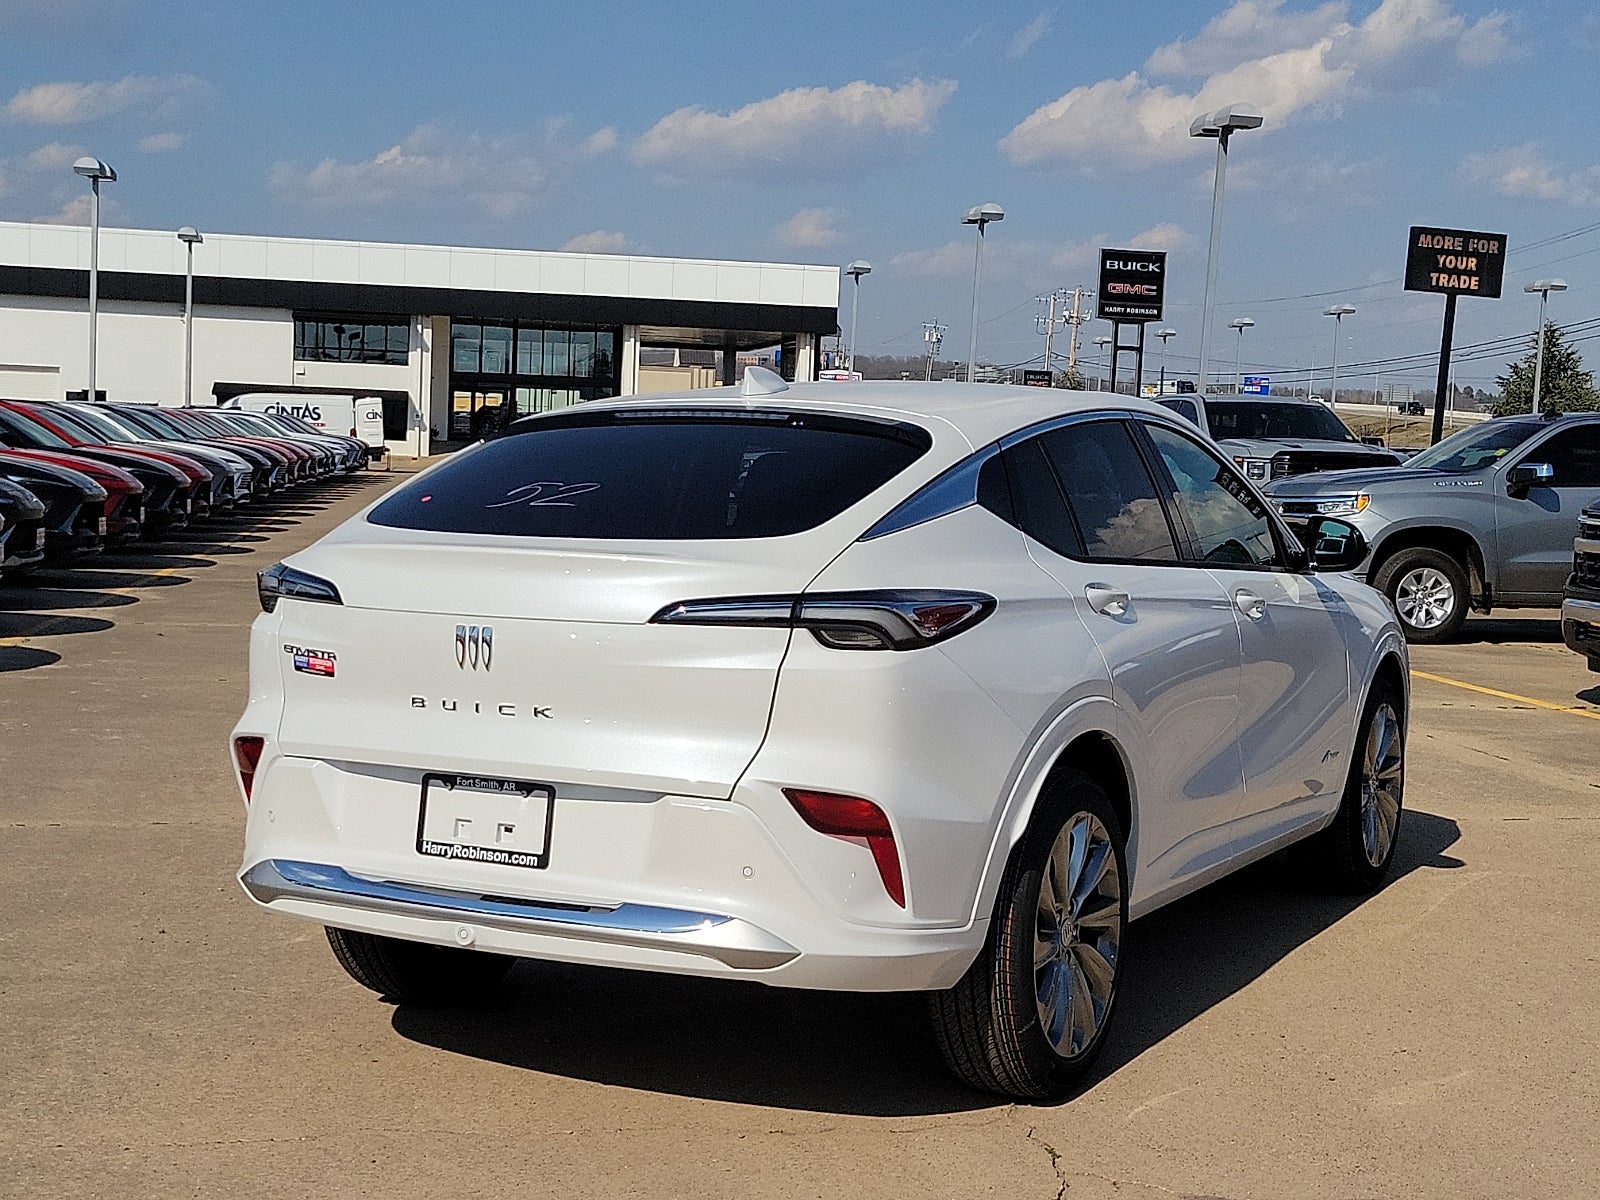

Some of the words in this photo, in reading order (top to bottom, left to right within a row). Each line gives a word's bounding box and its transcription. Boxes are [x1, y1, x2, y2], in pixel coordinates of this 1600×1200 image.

[1418, 234, 1463, 250] MORE
[1469, 239, 1499, 254] FOR
[1106, 260, 1161, 272] BUICK
[1437, 255, 1477, 271] YOUR
[1108, 283, 1157, 296] GMC
[1430, 273, 1479, 290] TRADE
[1104, 306, 1125, 314] HARRY
[1126, 307, 1158, 316] ROBINSON
[411, 697, 554, 719] BUICK
[456, 777, 474, 787] Fort
[475, 779, 501, 791] Smith,
[503, 782, 516, 791] AR
[422, 841, 538, 867] HarryRobinson.com
